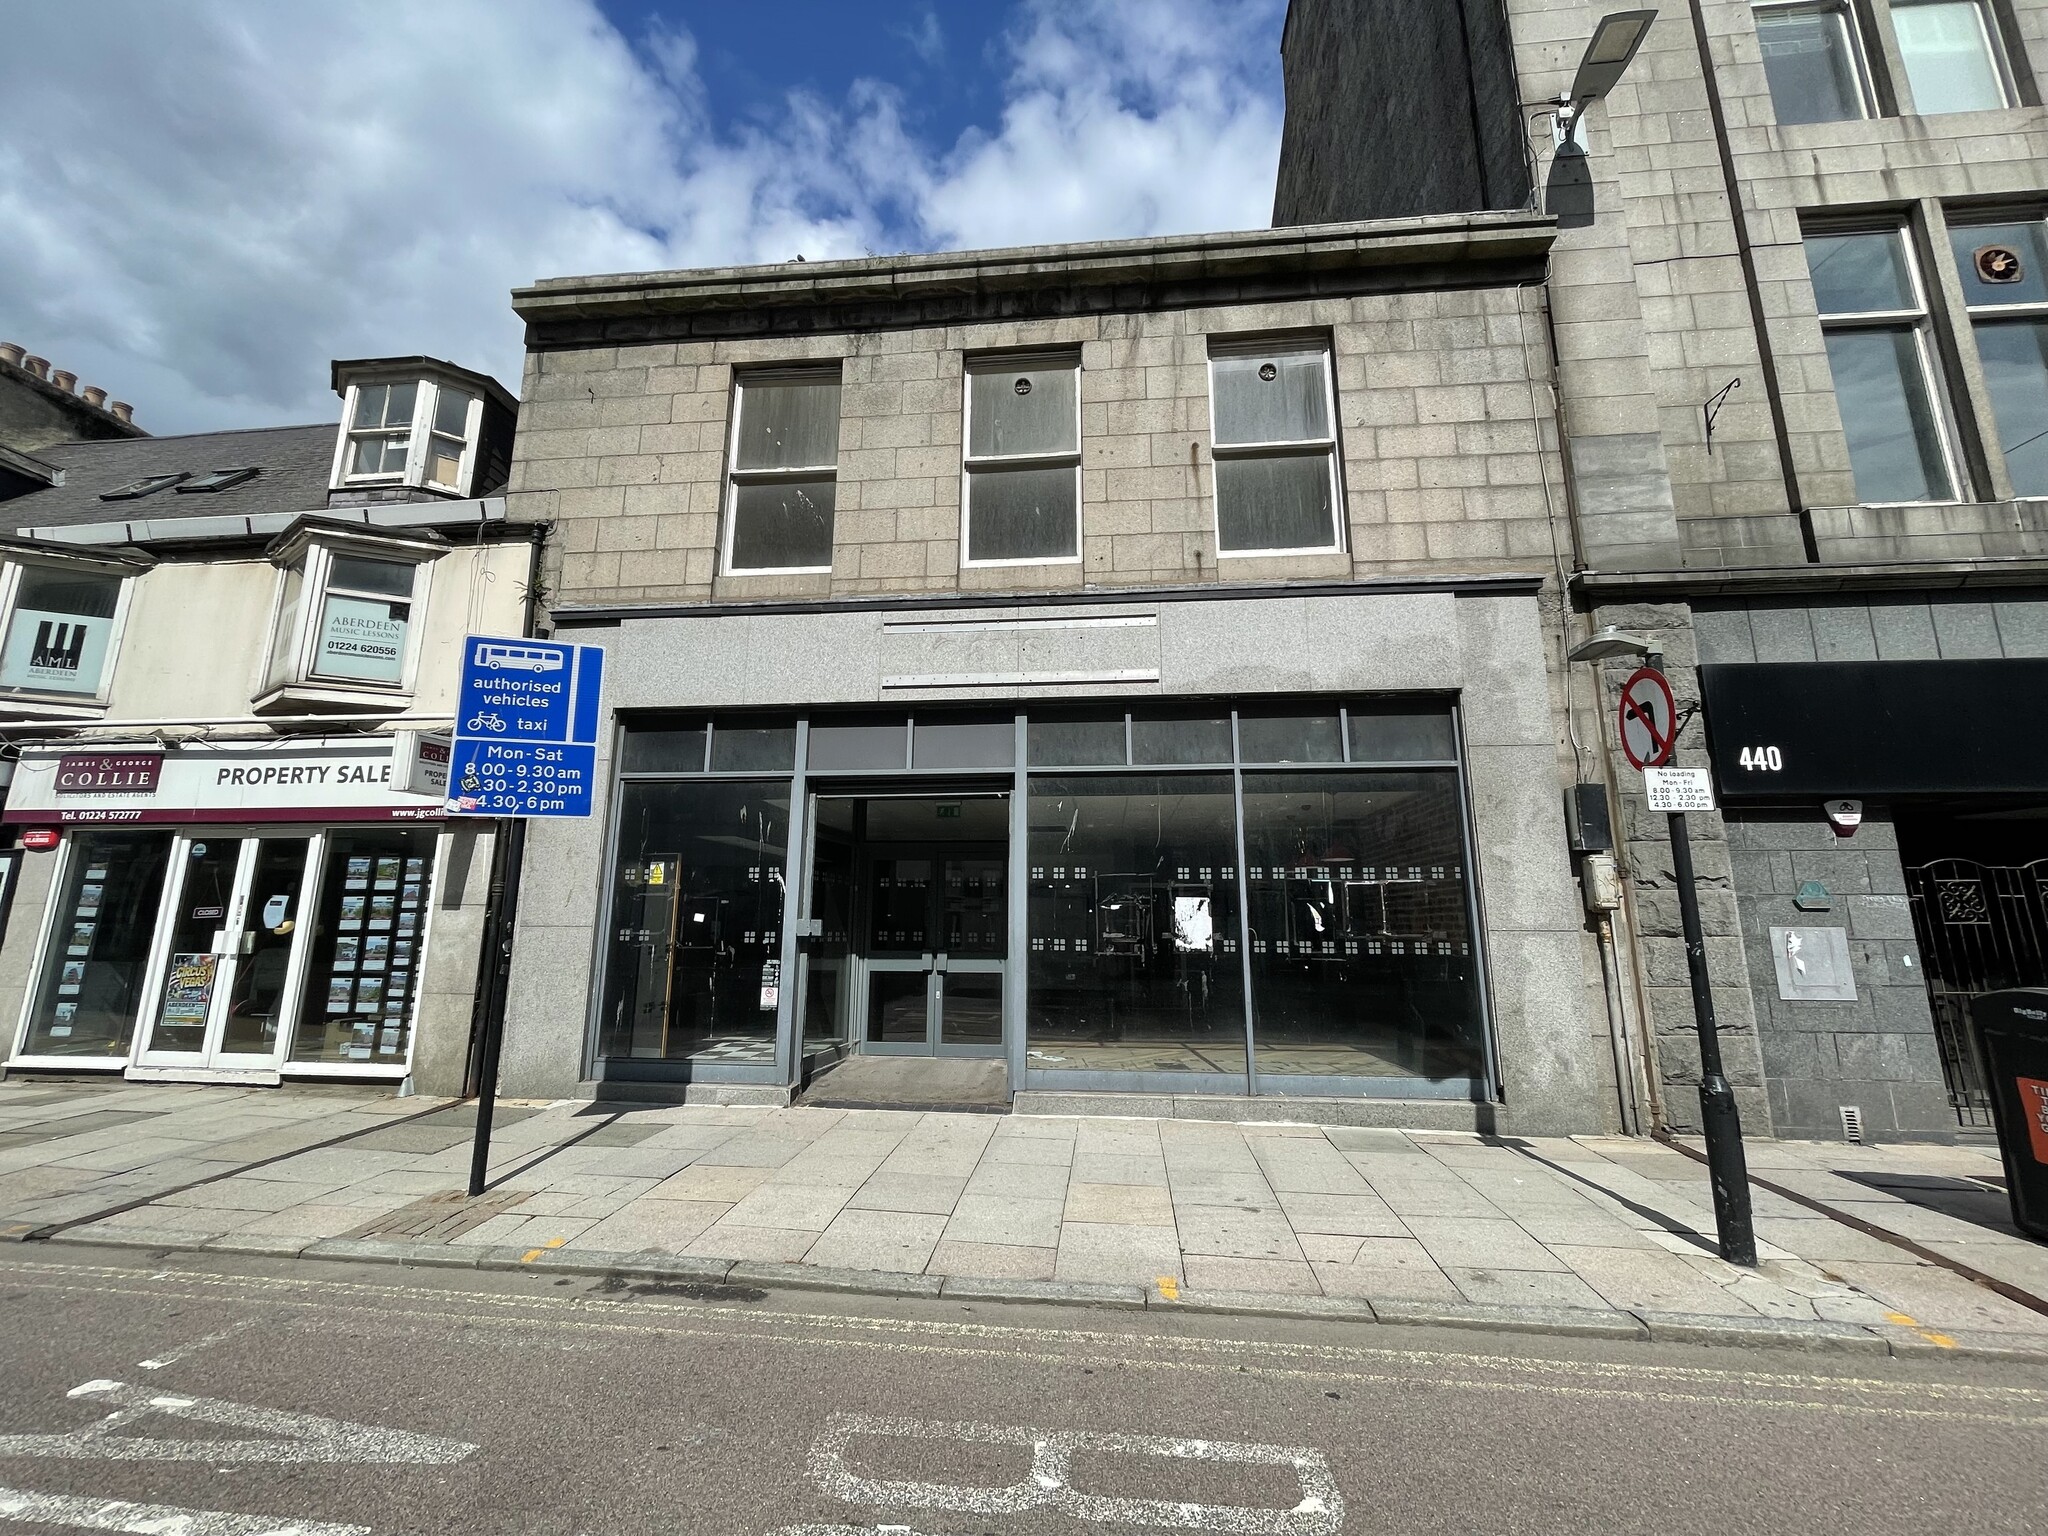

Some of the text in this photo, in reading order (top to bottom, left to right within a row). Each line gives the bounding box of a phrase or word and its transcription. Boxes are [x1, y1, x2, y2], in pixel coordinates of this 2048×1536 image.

[332, 616, 400, 631] ABERDEEN
[330, 626, 399, 639] MUSIC LESSONS
[328, 641, 396, 655] 01224 620556
[32, 656, 76, 669] AML
[473, 678, 561, 694] authorised
[483, 694, 549, 708] vehicles
[517, 718, 548, 731] taxi
[487, 746, 523, 760] Mon
[535, 748, 563, 761] Sat
[1740, 746, 1782, 771] 440
[99, 758, 113, 771] &
[61, 772, 151, 786] COLLIE
[217, 765, 391, 785] PROPERTY SALE
[425, 770, 447, 779] PROPE
[557, 769, 581, 779] am
[558, 786, 582, 796] pm
[540, 801, 565, 812] pm
[61, 811, 142, 820] Tel. 01224 572777
[176, 966, 207, 978] CIRCUS
[179, 977, 206, 988] VEGAS
